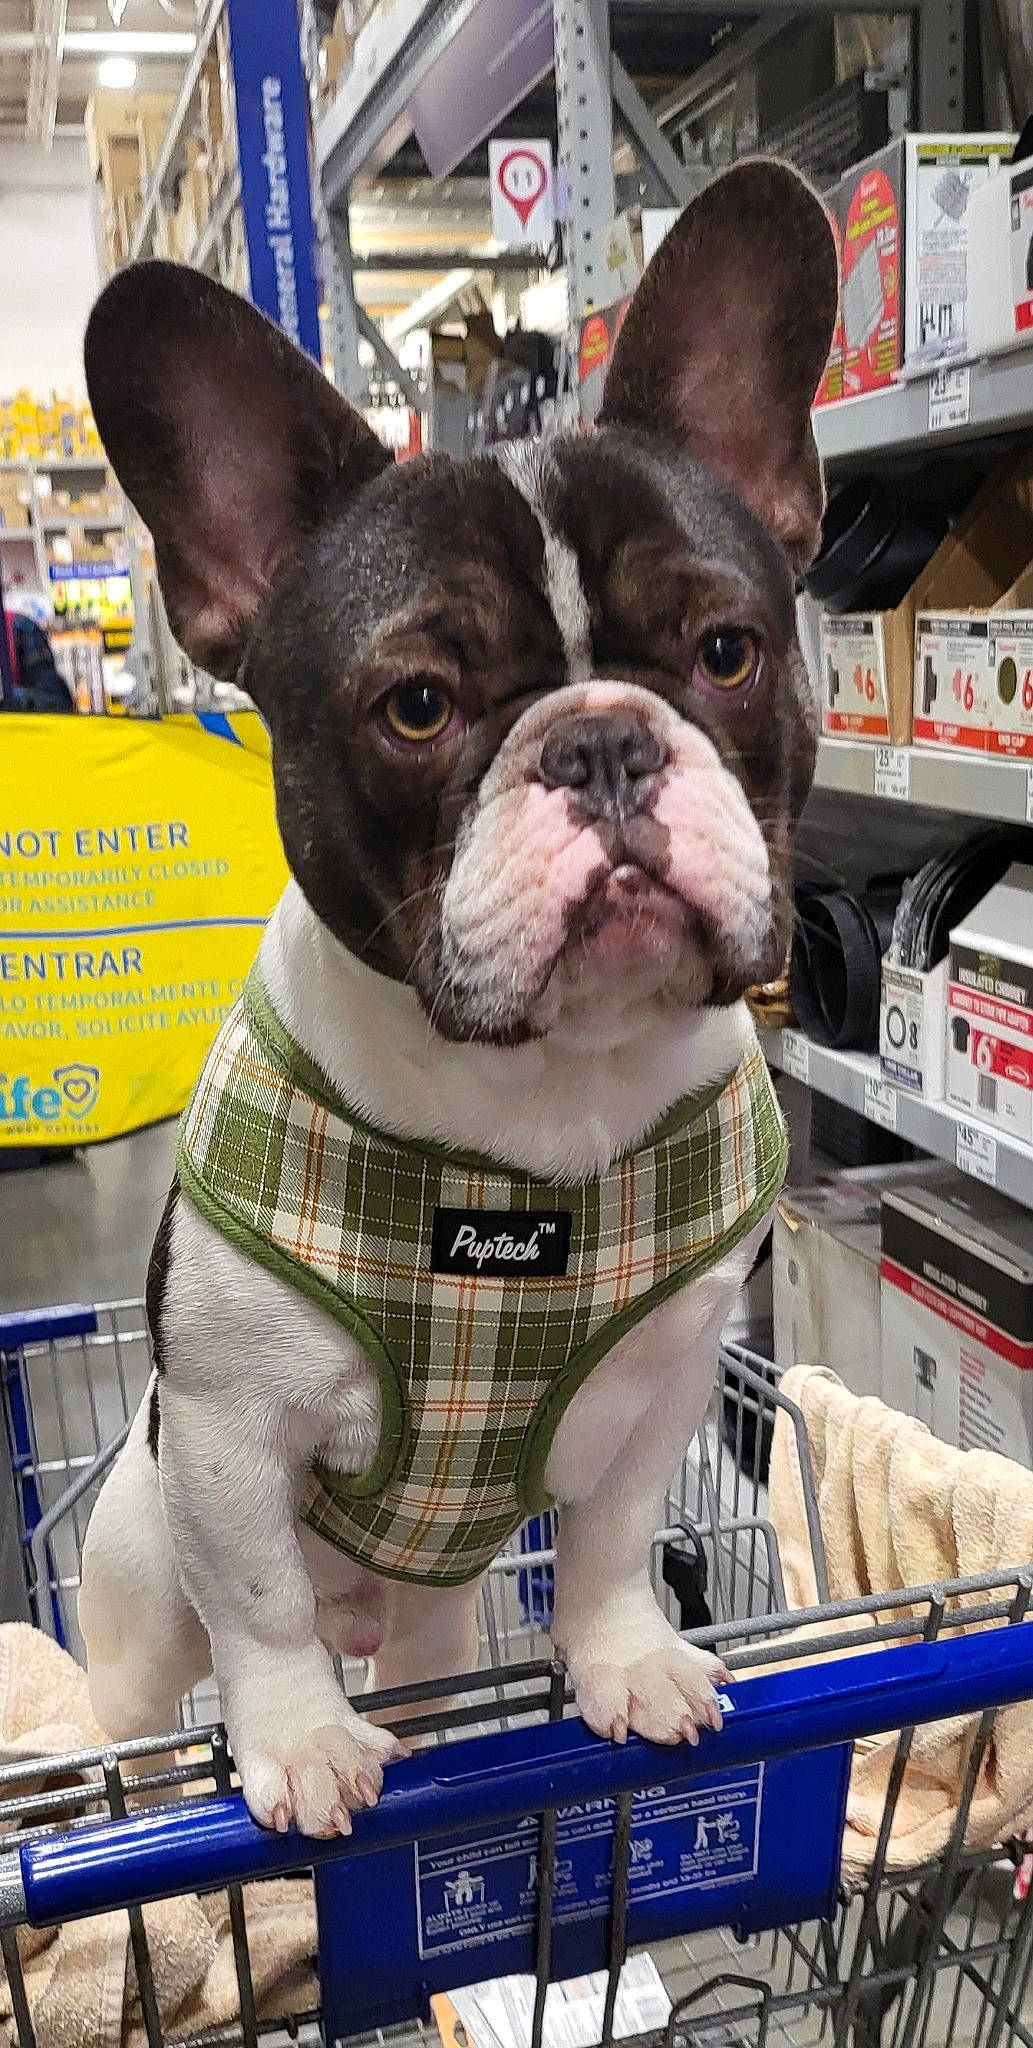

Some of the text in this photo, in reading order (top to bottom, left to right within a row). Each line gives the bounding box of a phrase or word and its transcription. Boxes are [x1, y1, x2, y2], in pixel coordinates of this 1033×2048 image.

[262, 76, 291, 232] Hardware
[75, 821, 189, 857] ENTER
[148, 859, 230, 882] CLOSED
[29, 890, 156, 914] ASSISTANCE
[0, 946, 144, 982] ENTRAR
[958, 966, 994, 994] INSULATED
[35, 981, 220, 1012] TEMPORALMENTE
[0, 1021, 69, 1041] AVOR,
[75, 1011, 169, 1038] SOLICITE
[450, 1225, 540, 1269] Puptech
